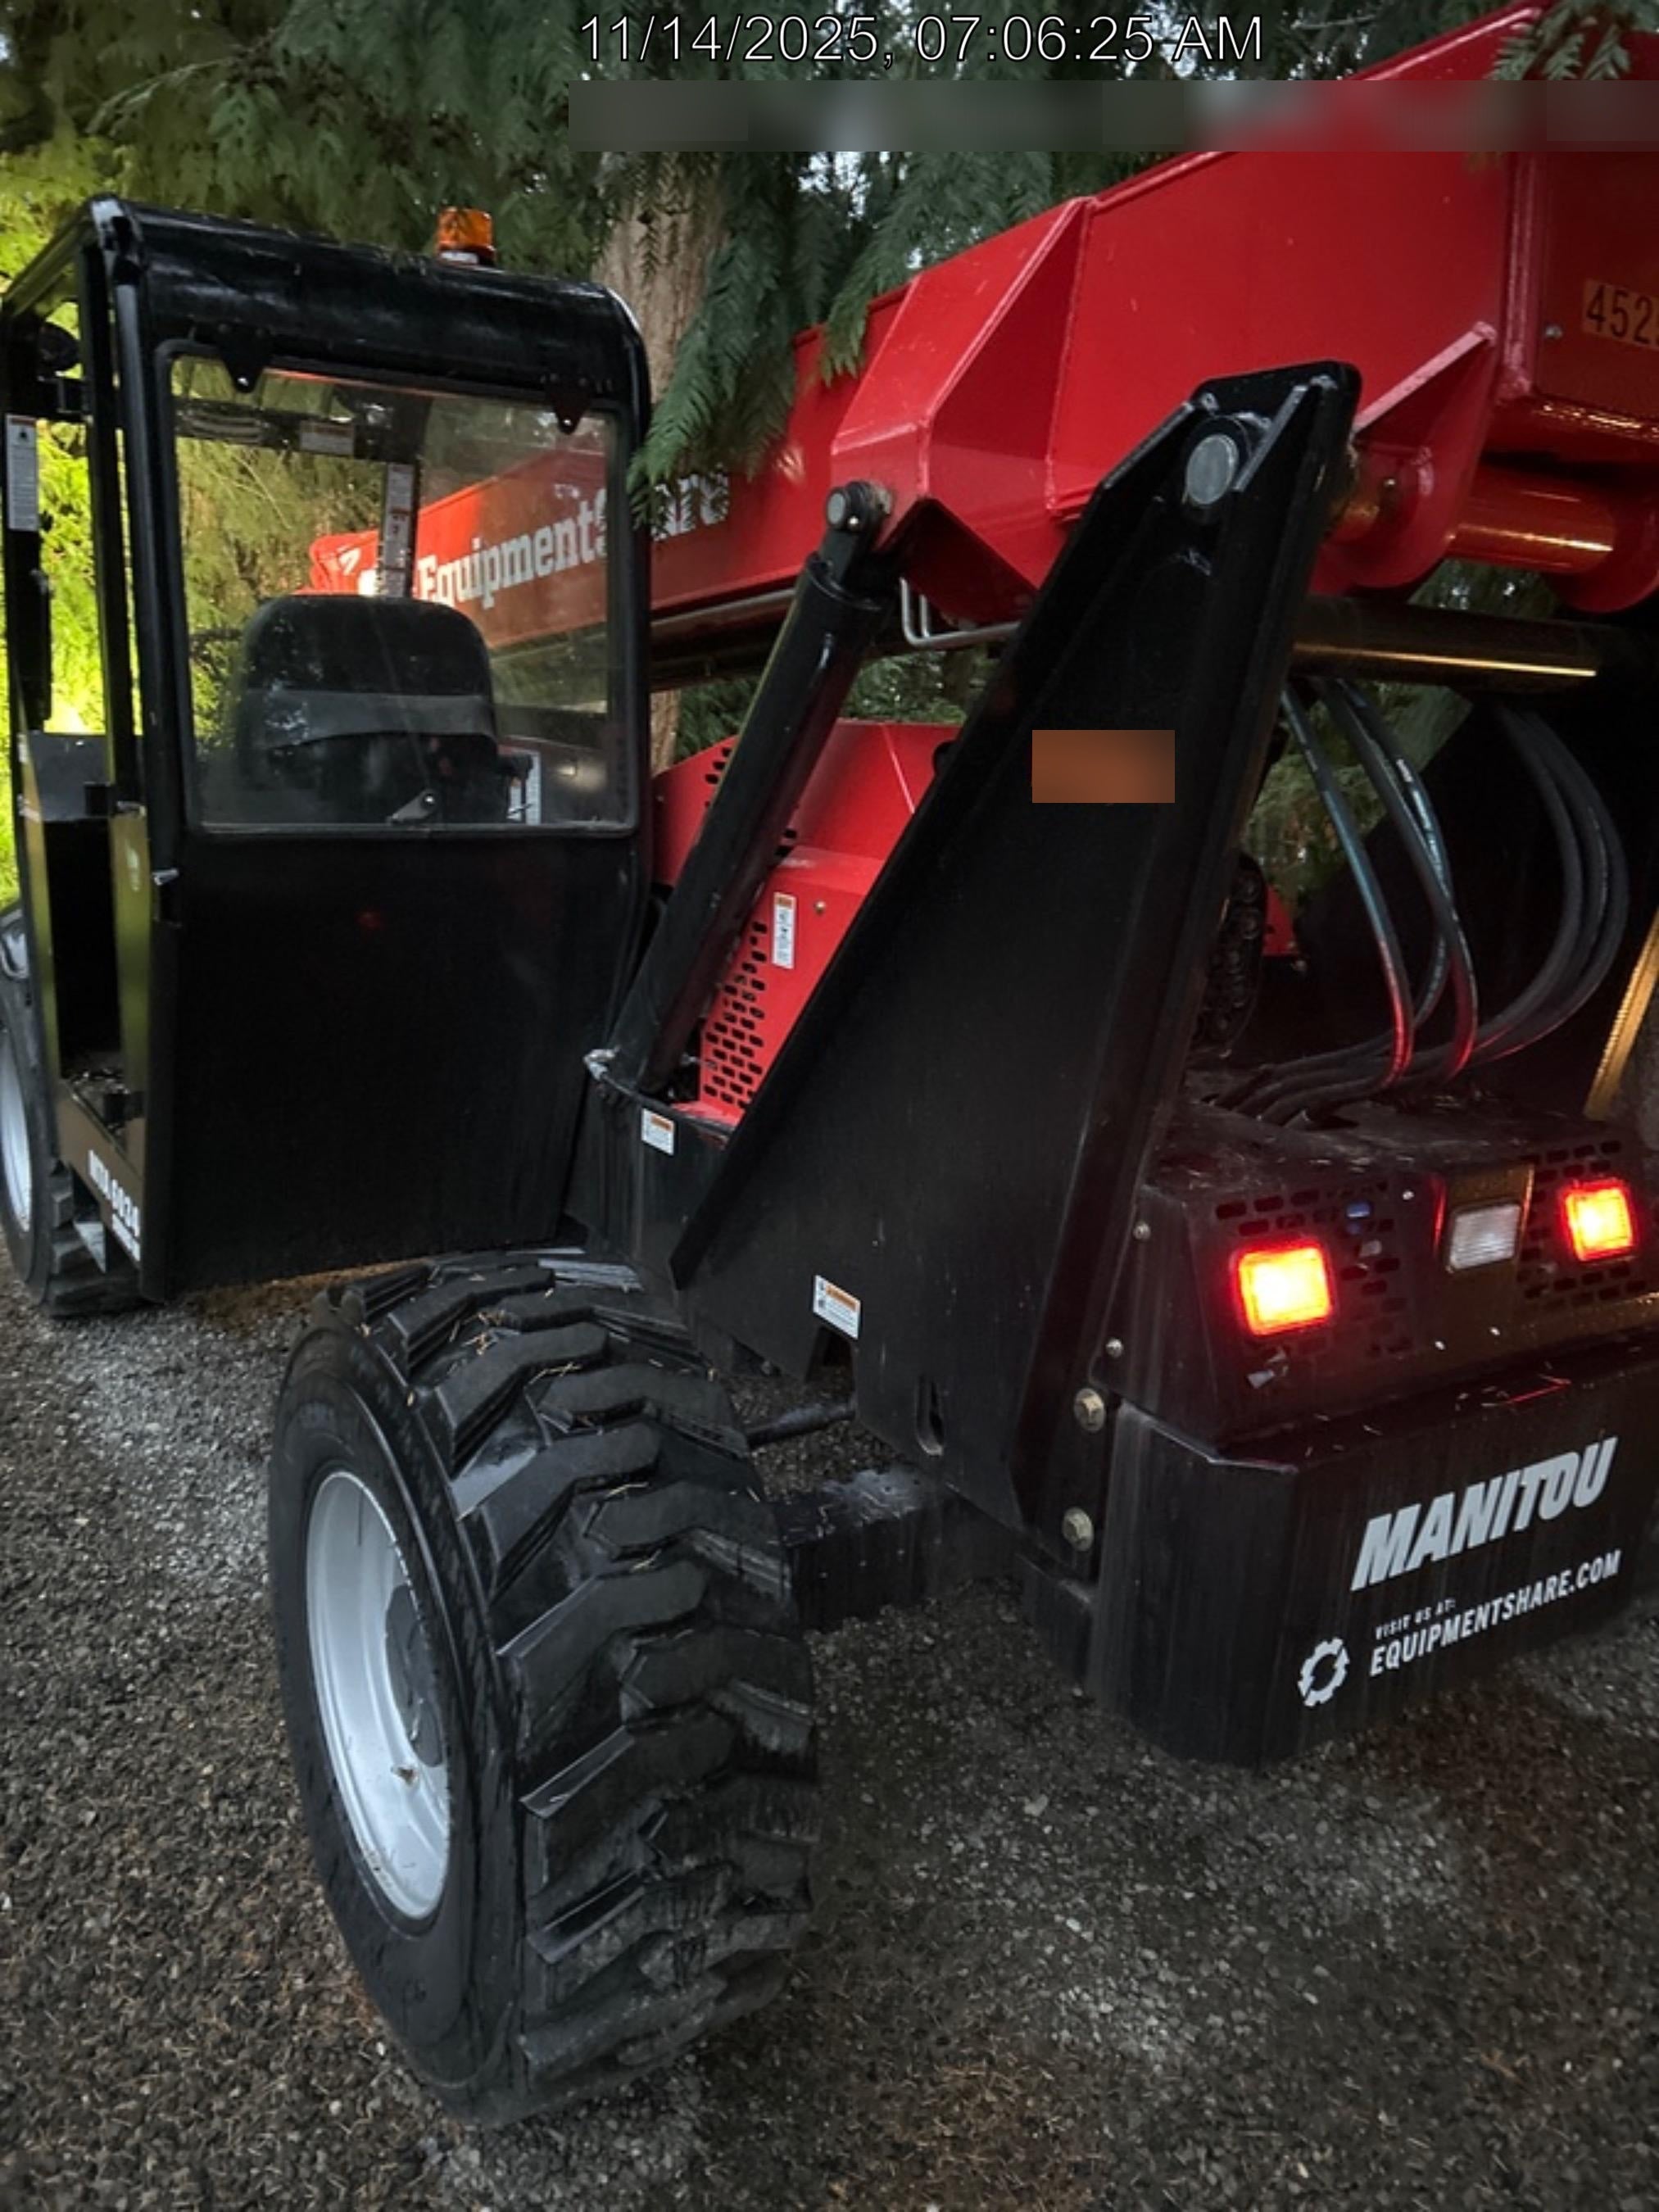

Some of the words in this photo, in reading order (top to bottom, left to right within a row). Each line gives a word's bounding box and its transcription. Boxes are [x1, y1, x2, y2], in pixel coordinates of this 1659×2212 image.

[1586, 284, 1659, 345] 452
[1350, 1436, 1620, 1592] MANITOU
[1370, 1548, 1622, 1677] EQUIPMENTSHARE.COM
